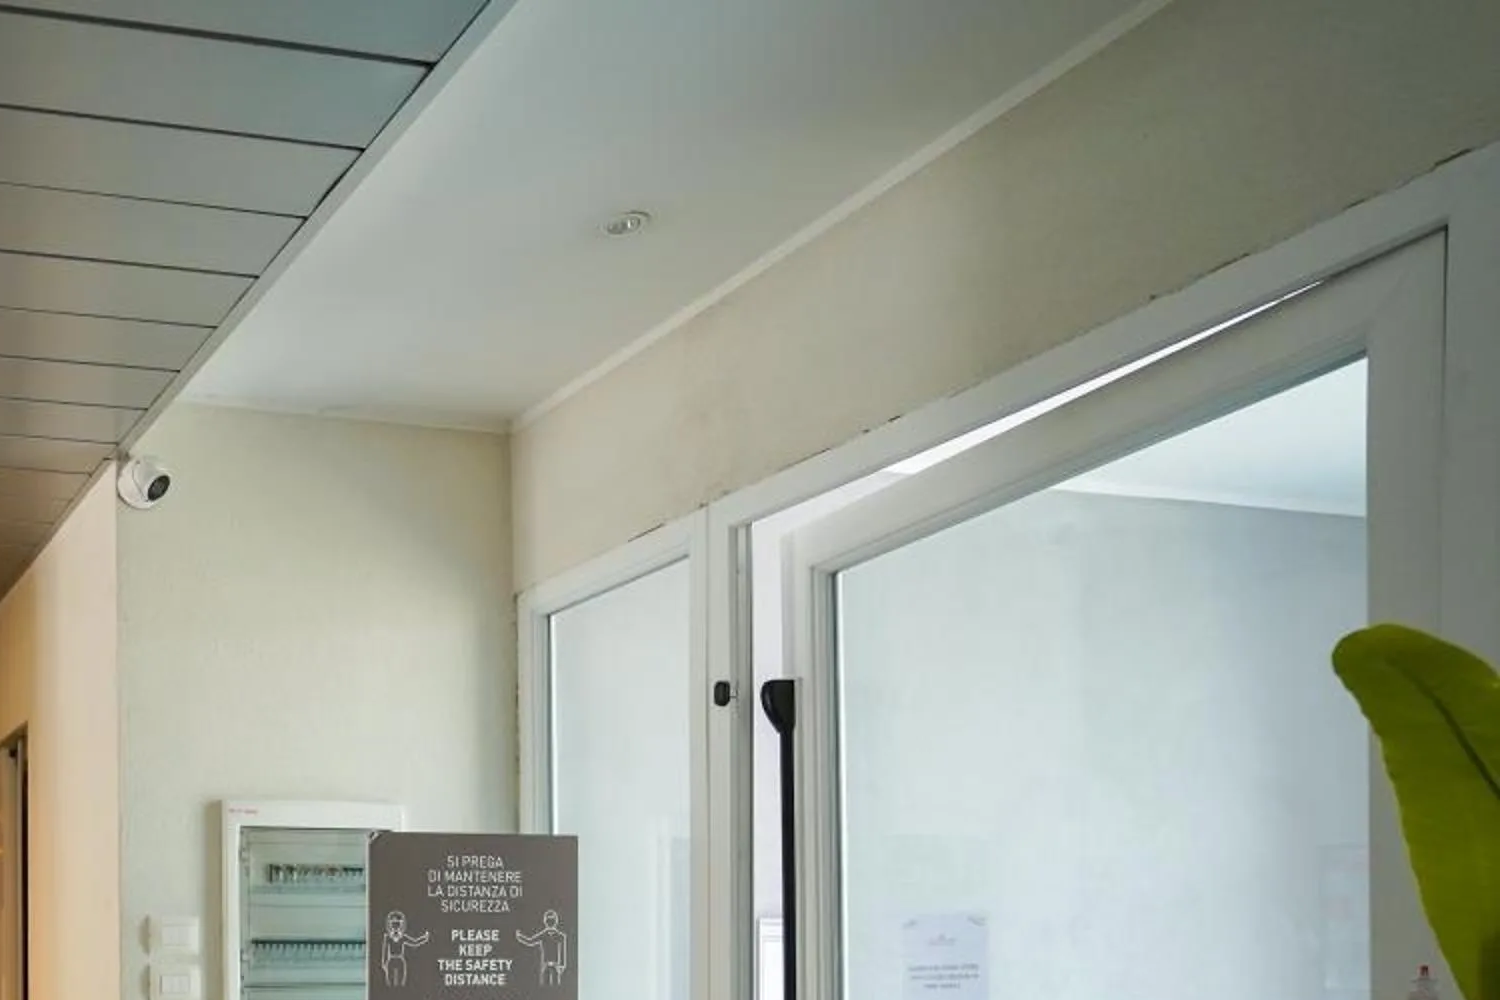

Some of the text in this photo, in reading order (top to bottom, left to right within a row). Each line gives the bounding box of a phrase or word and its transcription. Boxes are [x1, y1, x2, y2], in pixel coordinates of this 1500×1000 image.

[447, 855, 504, 868] SI PREGA
[428, 870, 522, 883] DI MANTENERE
[427, 885, 523, 898] LA DISTANZA DI
[440, 900, 510, 913] SICUREZZA
[451, 930, 500, 942] PLEASE
[459, 944, 492, 956] KEEP
[437, 959, 513, 971] THE SAFETY
[444, 973, 507, 985] DISTANCE
